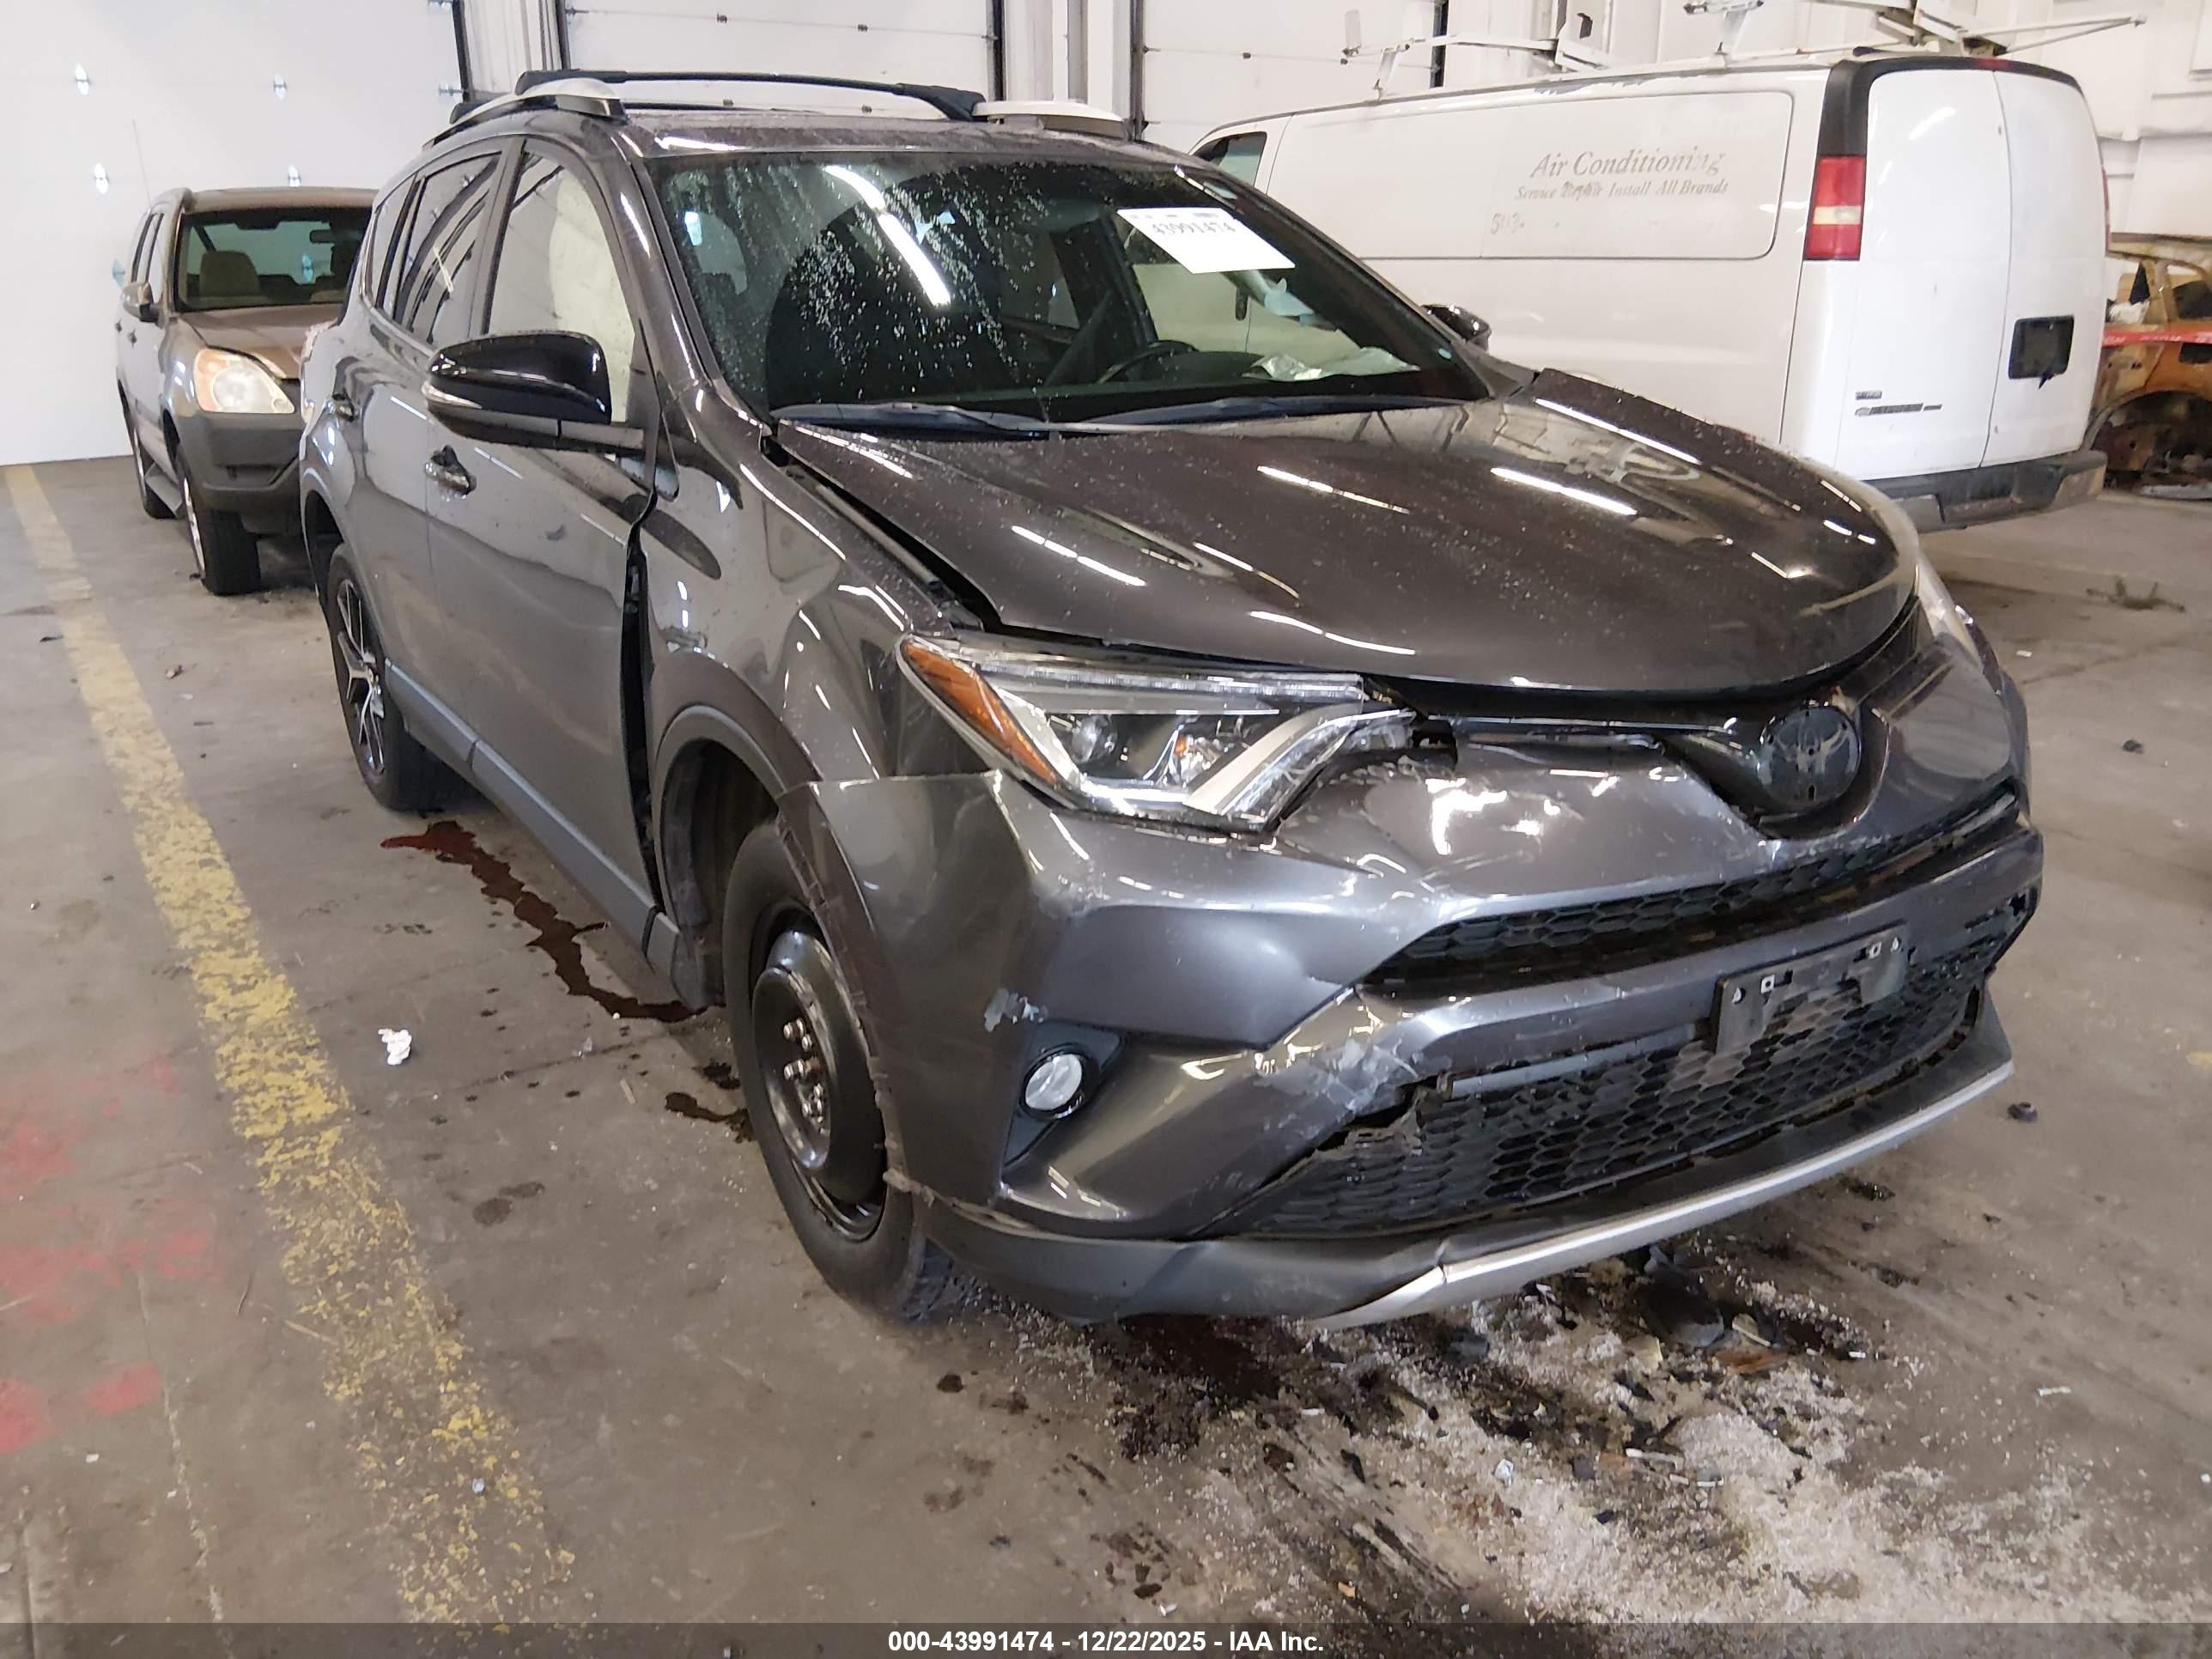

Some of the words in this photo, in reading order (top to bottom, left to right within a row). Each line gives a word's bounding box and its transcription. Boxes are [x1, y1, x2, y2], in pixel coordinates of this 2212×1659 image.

[1529, 152, 1568, 178] Air
[1607, 180, 1651, 198] Install
[1655, 179, 1676, 195] All
[1678, 179, 1729, 195] Brands
